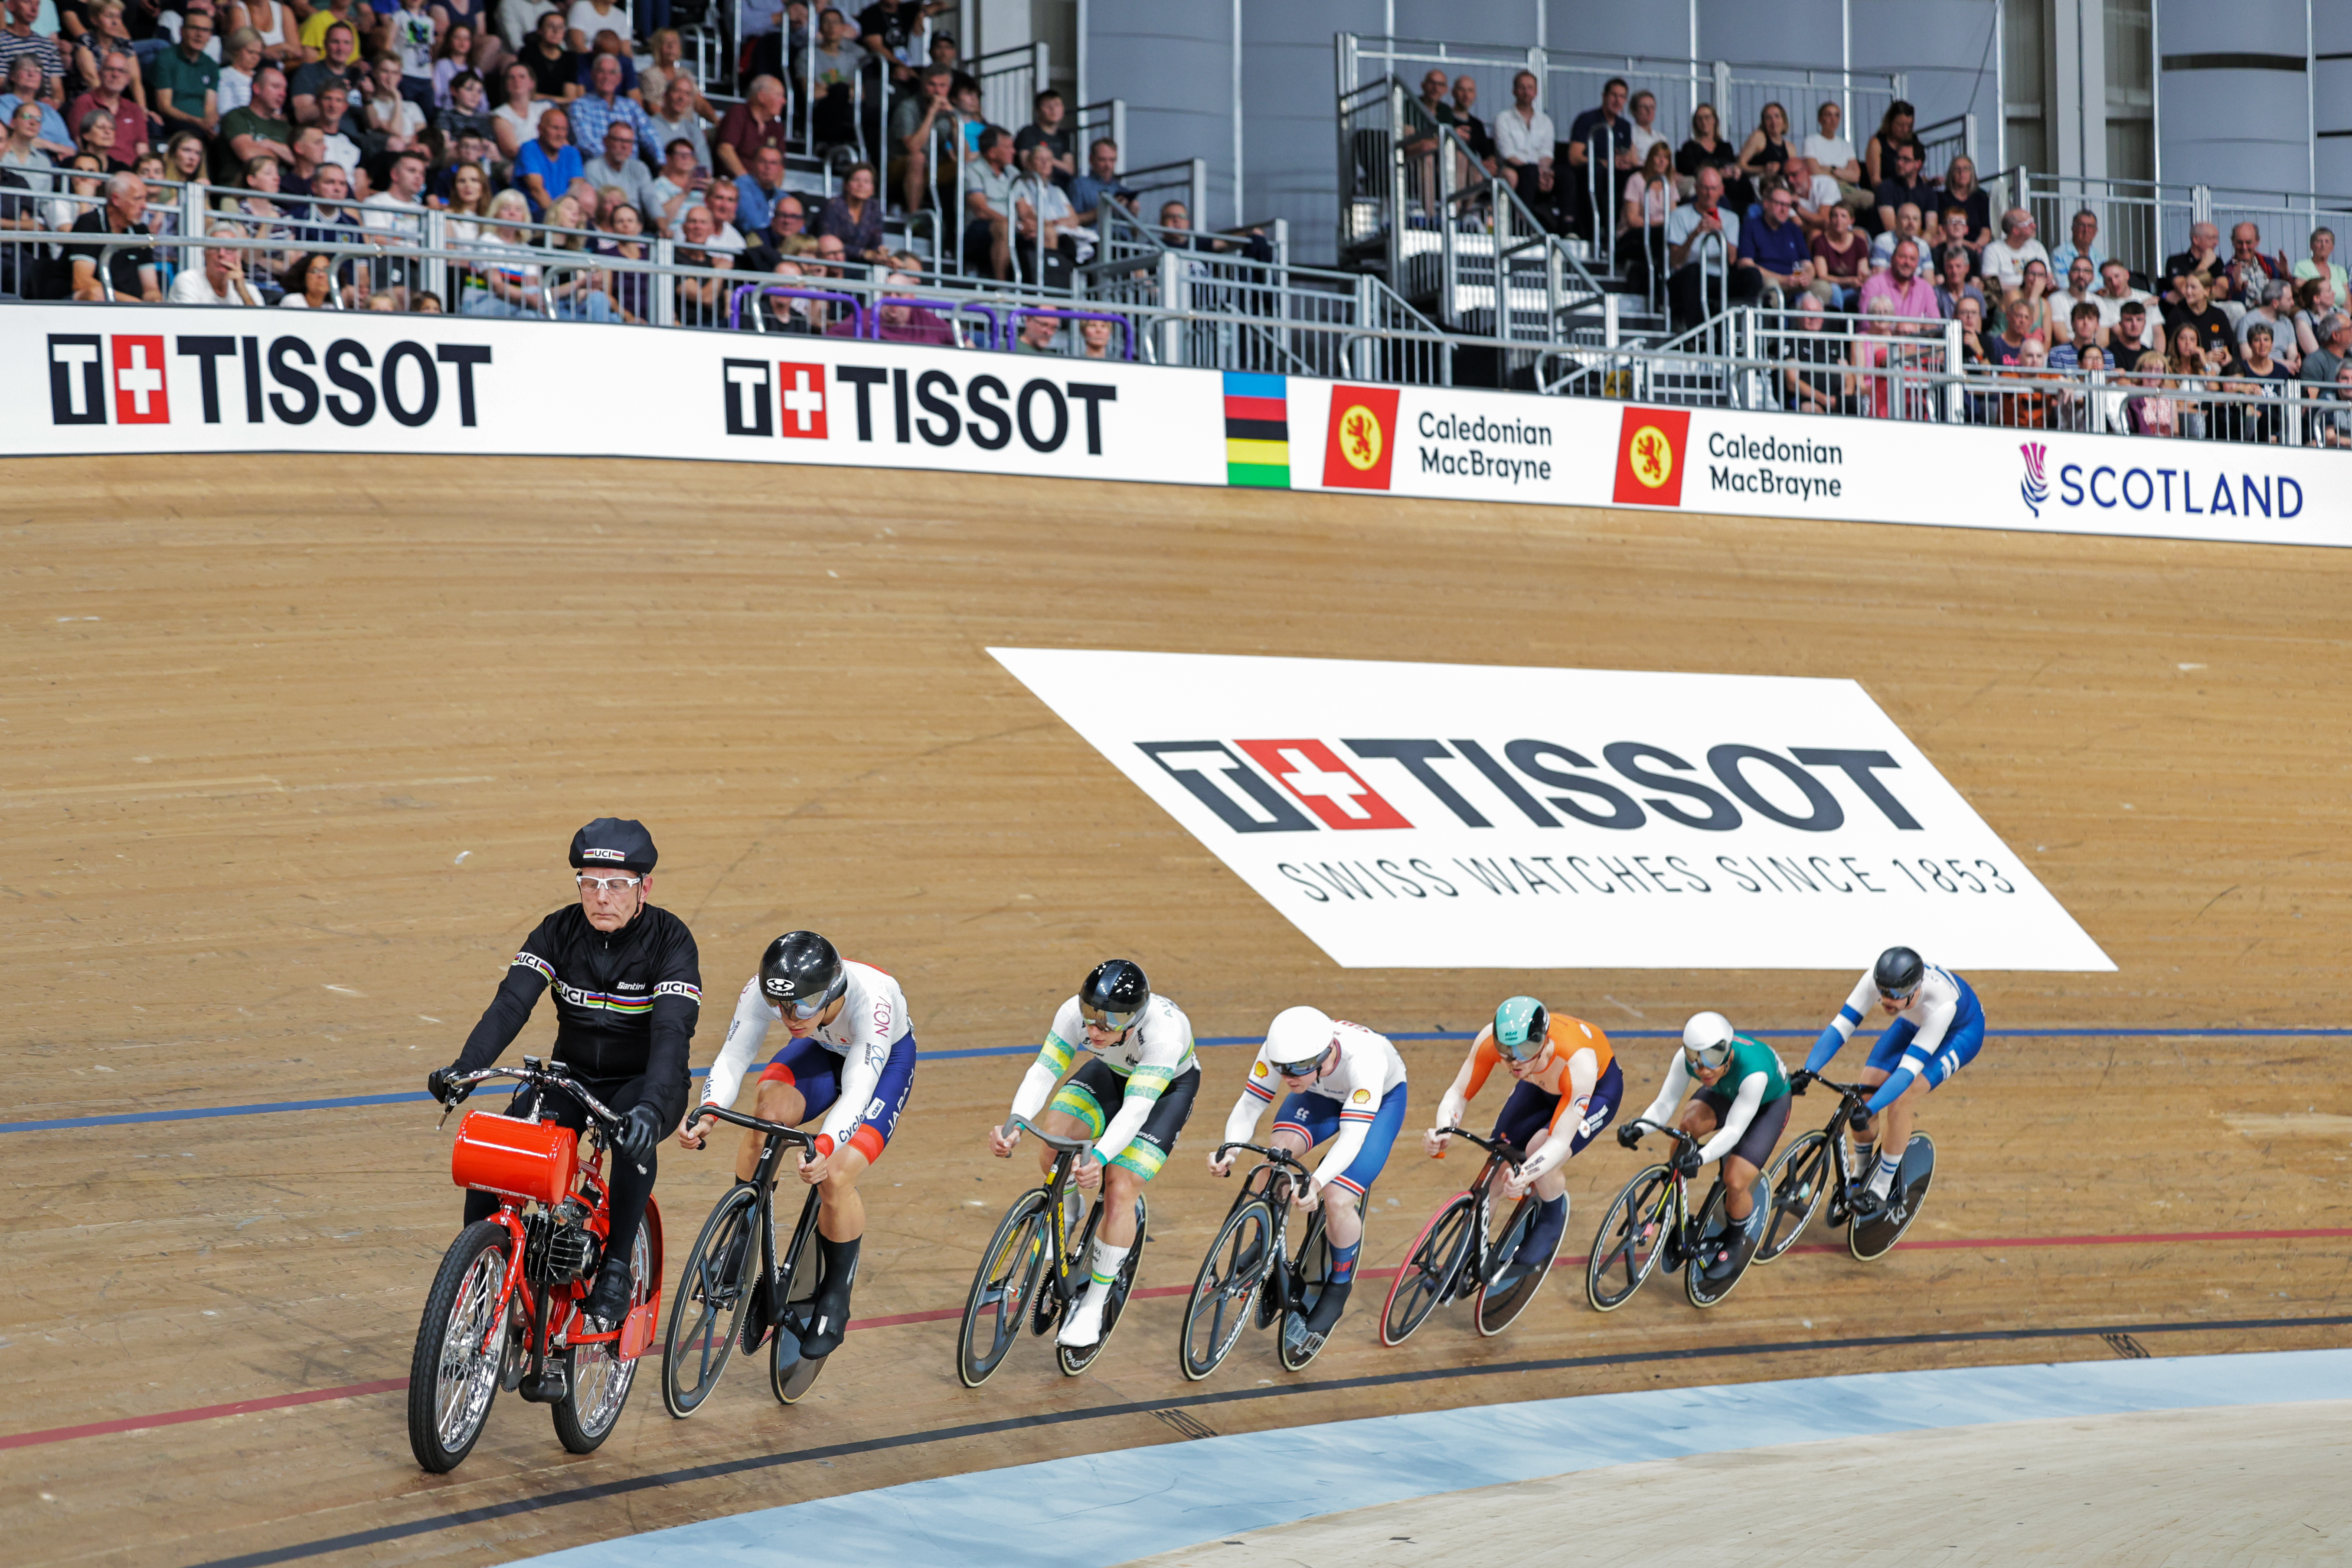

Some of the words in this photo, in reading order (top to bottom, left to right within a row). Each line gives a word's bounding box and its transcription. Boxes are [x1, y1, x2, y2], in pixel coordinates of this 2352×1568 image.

[177, 336, 491, 426] TISSOT
[837, 366, 1116, 454] TISSOT
[1419, 412, 1551, 445] Caledonian
[1420, 446, 1551, 483] MacBrayne
[1709, 432, 1841, 464] Caledonian
[1710, 465, 1841, 501] MacBrayne
[2061, 464, 2303, 518] SCOTLAND
[1341, 739, 1923, 832] TISSOT
[1277, 859, 1458, 902] SWISS
[1454, 856, 1711, 896] WATCHES
[1716, 856, 1885, 892] SINCE
[1892, 859, 2015, 894] 1853
[519, 954, 539, 968] UCI
[560, 983, 585, 1005] UCI
[616, 981, 646, 991] Santini
[660, 983, 685, 994] UCI
[767, 988, 794, 996] Kabuto
[1067, 1079, 1097, 1094] Santini
[1136, 1130, 1161, 1144] antini
[1262, 1214, 1289, 1277] LOTUS
[1480, 1193, 1490, 1268] KOGA
